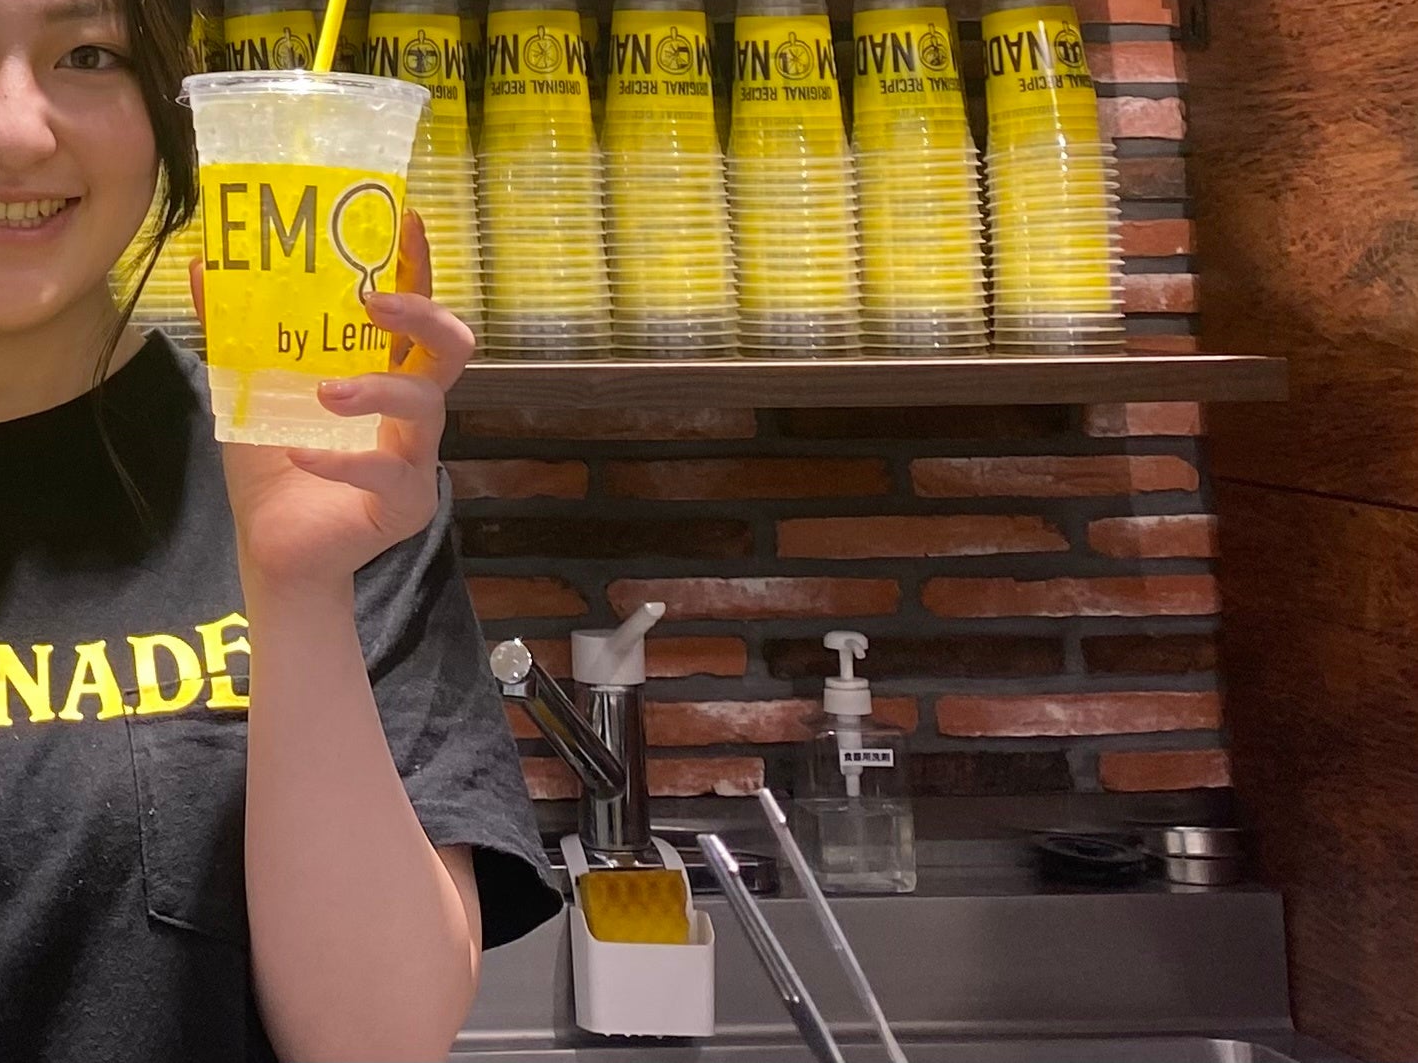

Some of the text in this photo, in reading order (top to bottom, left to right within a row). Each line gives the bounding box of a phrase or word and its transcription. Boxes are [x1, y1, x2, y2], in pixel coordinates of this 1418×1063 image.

[490, 80, 582, 95] ORIGINAL RECIPE
[619, 80, 658, 95] RECIPE
[740, 86, 832, 101] ORIGINAL RECIPE
[880, 79, 924, 94] RECIPE
[278, 322, 309, 361] by
